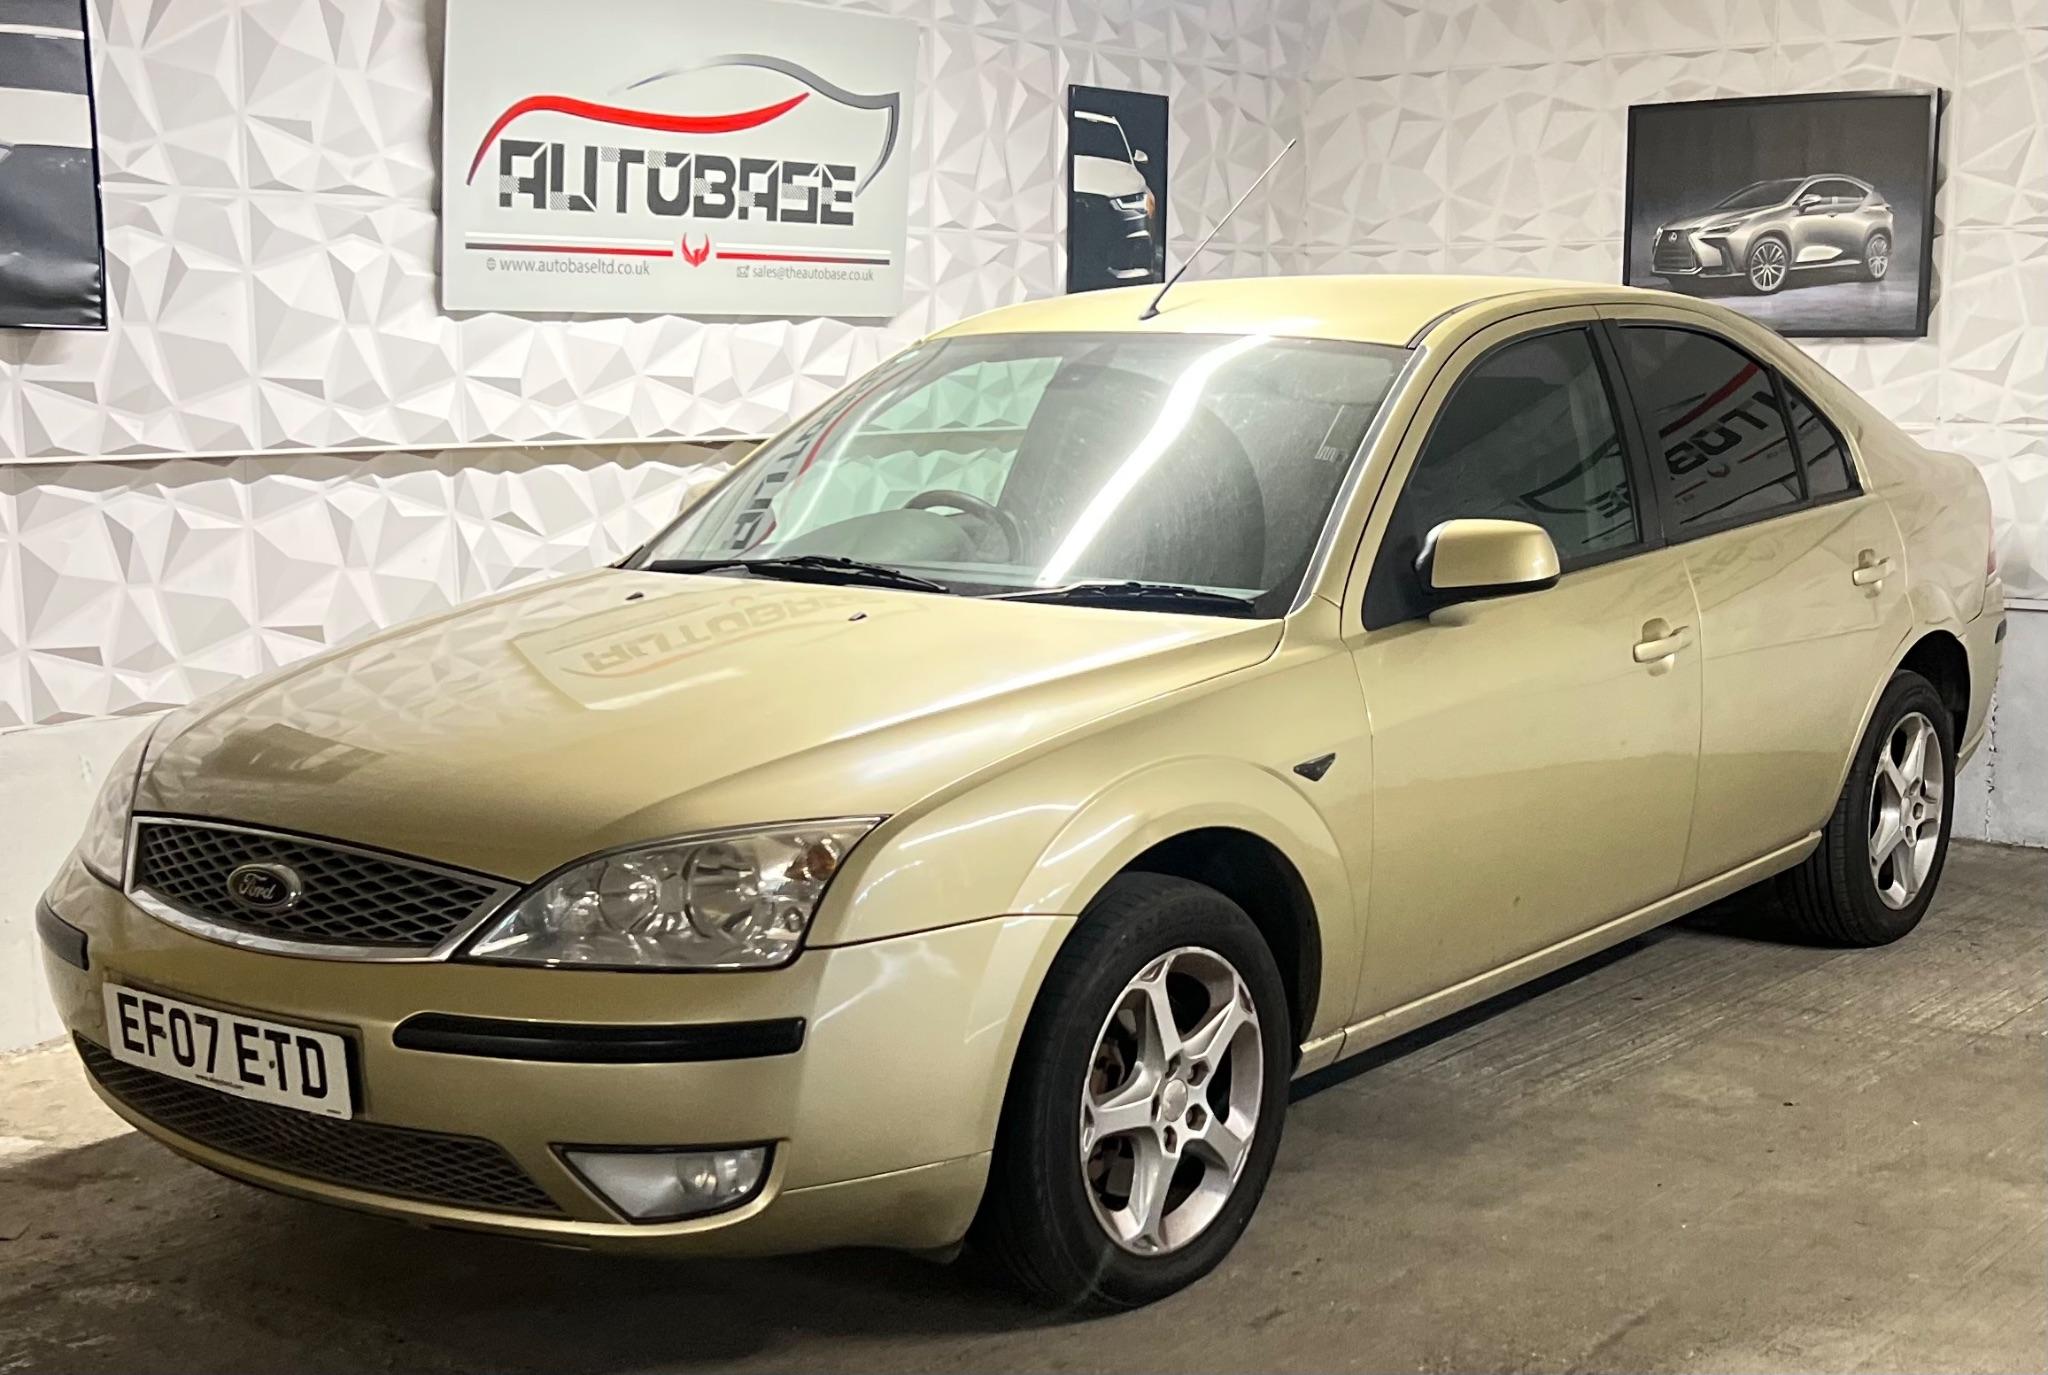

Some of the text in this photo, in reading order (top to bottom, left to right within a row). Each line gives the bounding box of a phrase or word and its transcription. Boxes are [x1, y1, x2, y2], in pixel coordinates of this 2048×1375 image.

[499, 138, 857, 227] AUTOBASE
[500, 257, 651, 277] www.autobaseltd.co.uk
[752, 266, 875, 283] sales@theautobase.co.uk
[239, 873, 277, 900] Ford
[117, 992, 329, 1099] EF07 ETD
